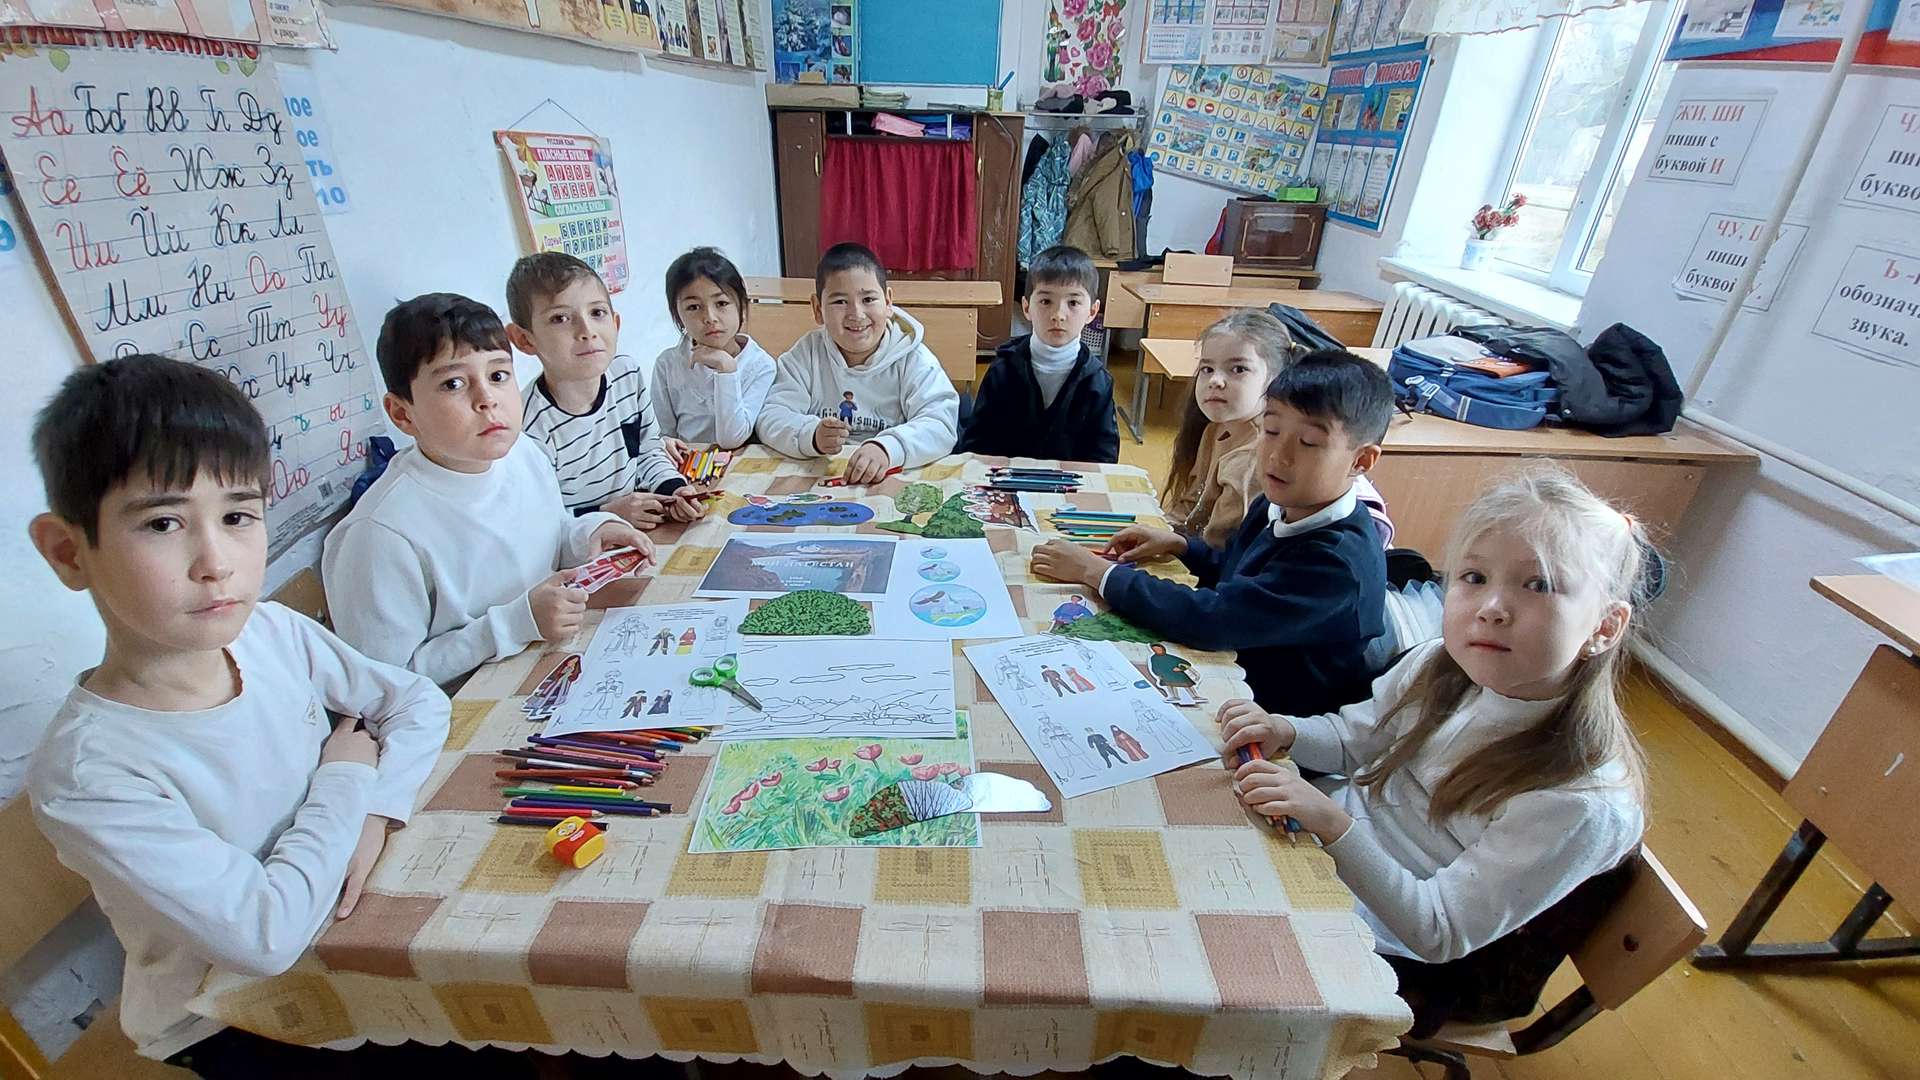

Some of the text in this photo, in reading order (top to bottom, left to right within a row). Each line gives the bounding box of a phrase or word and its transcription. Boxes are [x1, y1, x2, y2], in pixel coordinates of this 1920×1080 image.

[12, 85, 281, 145] Аа Бб Вв Гг Дд
[1712, 105, 1746, 121] ШИ
[537, 149, 569, 161] ГЛАСНЫЕ
[1665, 134, 1719, 148] пиши с
[38, 145, 294, 205] Ее Ёё Жж Зз
[1655, 154, 1726, 174] буквой И
[1888, 150, 1920, 168] пи
[56, 222, 120, 271] Ии
[131, 205, 190, 257] Йй
[210, 203, 255, 246] Кк
[269, 199, 304, 238] Лл
[96, 246, 334, 332] Мм Нн Оо Пп
[1840, 284, 1920, 319] обознач
[189, 323, 222, 361] Сс
[247, 305, 296, 346] Тт
[313, 293, 347, 338] Уу
[1849, 318, 1909, 347] звука.
[268, 352, 312, 393] Цц
[318, 340, 355, 373] Чч
[330, 403, 346, 422] ы
[336, 429, 369, 466] Яя
